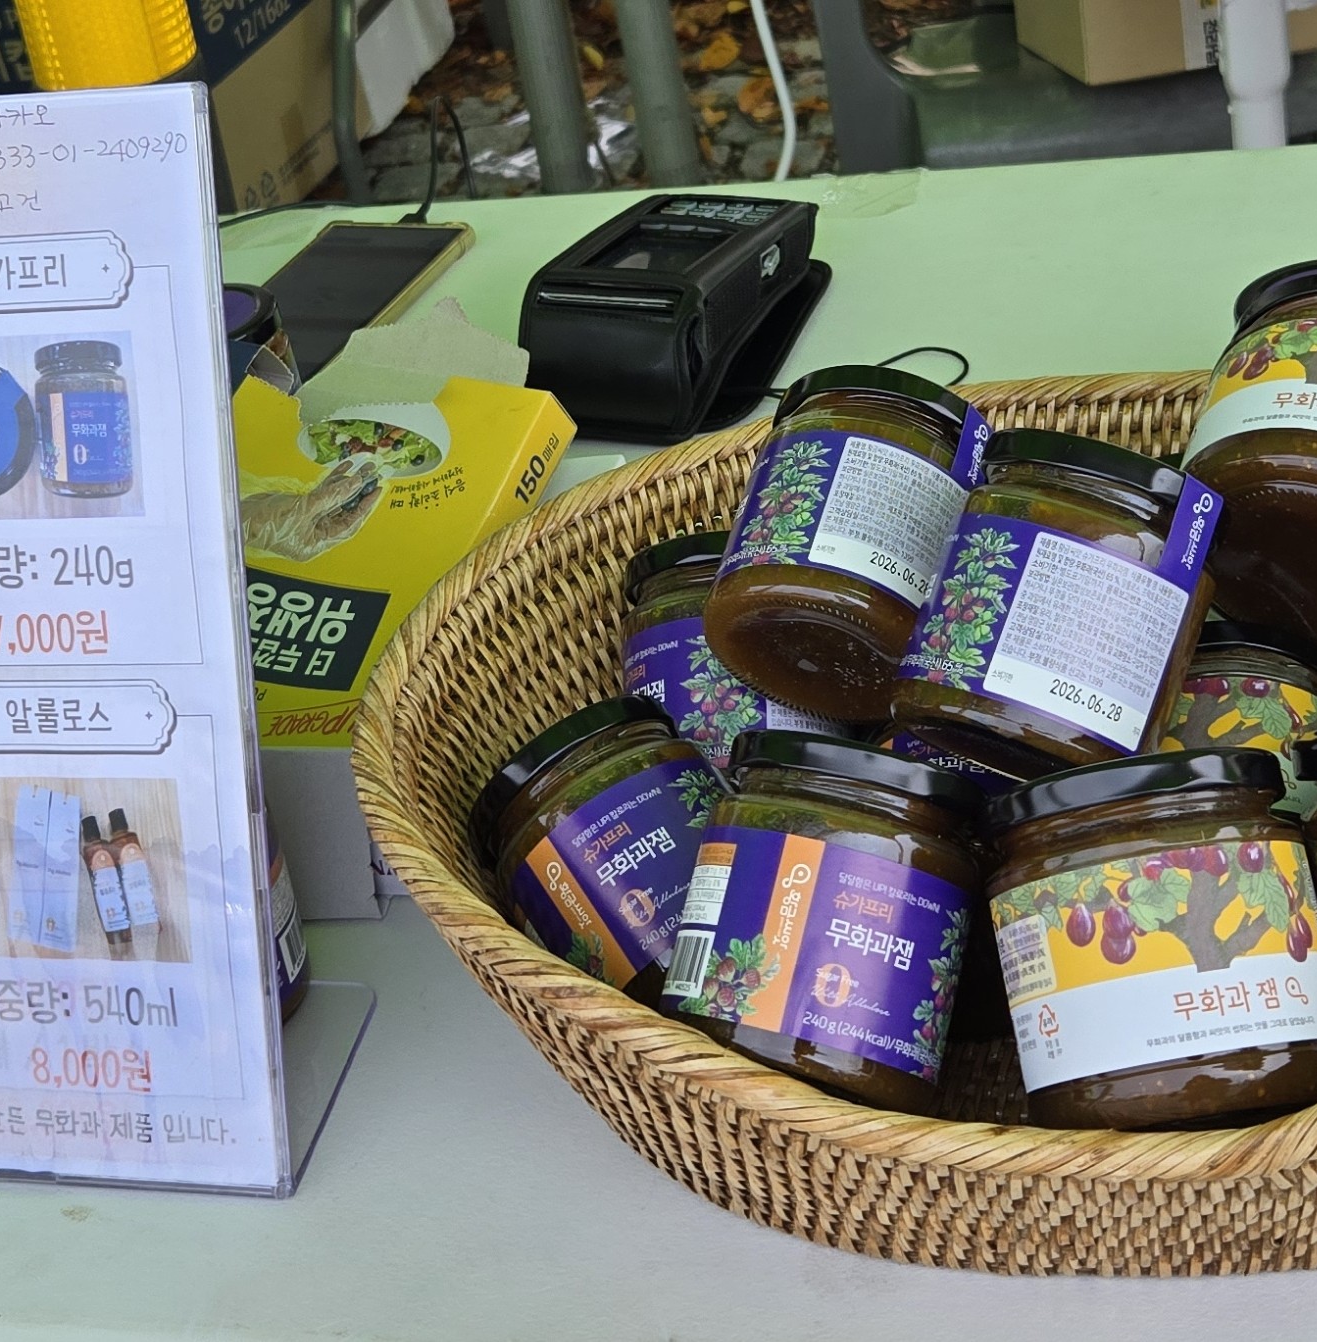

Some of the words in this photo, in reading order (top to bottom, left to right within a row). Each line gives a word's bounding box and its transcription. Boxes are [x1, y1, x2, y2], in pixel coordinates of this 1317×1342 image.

[71, 423, 108, 438] 무화과잼
[409, 484, 440, 511] 조리할
[444, 477, 466, 502] 음식
[514, 455, 547, 505] 150
[389, 497, 404, 511] 때
[49, 544, 135, 590] 240g
[304, 648, 335, 676] 더
[3, 697, 114, 736] 알룰로스
[1047, 678, 1126, 723] 2026.06.28
[576, 820, 637, 866] 슈가프리
[589, 824, 681, 892] 무화과잼
[616, 896, 641, 917] Sugar
[635, 885, 656, 902] Free
[771, 888, 802, 951] 황금씨앗
[830, 889, 895, 924] 슈가프리
[821, 917, 917, 971] 무화과잼
[811, 960, 855, 1011] 0
[814, 967, 841, 985] Sugar
[841, 974, 861, 988] Free
[83, 985, 179, 1028] 540ml
[844, 991, 894, 1018] Allulose
[1172, 981, 1251, 1021] 무화과
[1256, 977, 1281, 1010] 잼
[1146, 1034, 1176, 1048] 무화과의
[1177, 1028, 1207, 1043] 달콤함과
[1208, 1025, 1231, 1037] 씨앗의
[1254, 1021, 1268, 1031] 맛을
[1269, 1017, 1288, 1028] 그대로
[31, 1047, 152, 1093] 8,000원
[34, 1108, 103, 1140] 무화과
[110, 1111, 155, 1145] 제품
[162, 1114, 238, 1147] 입니다.
